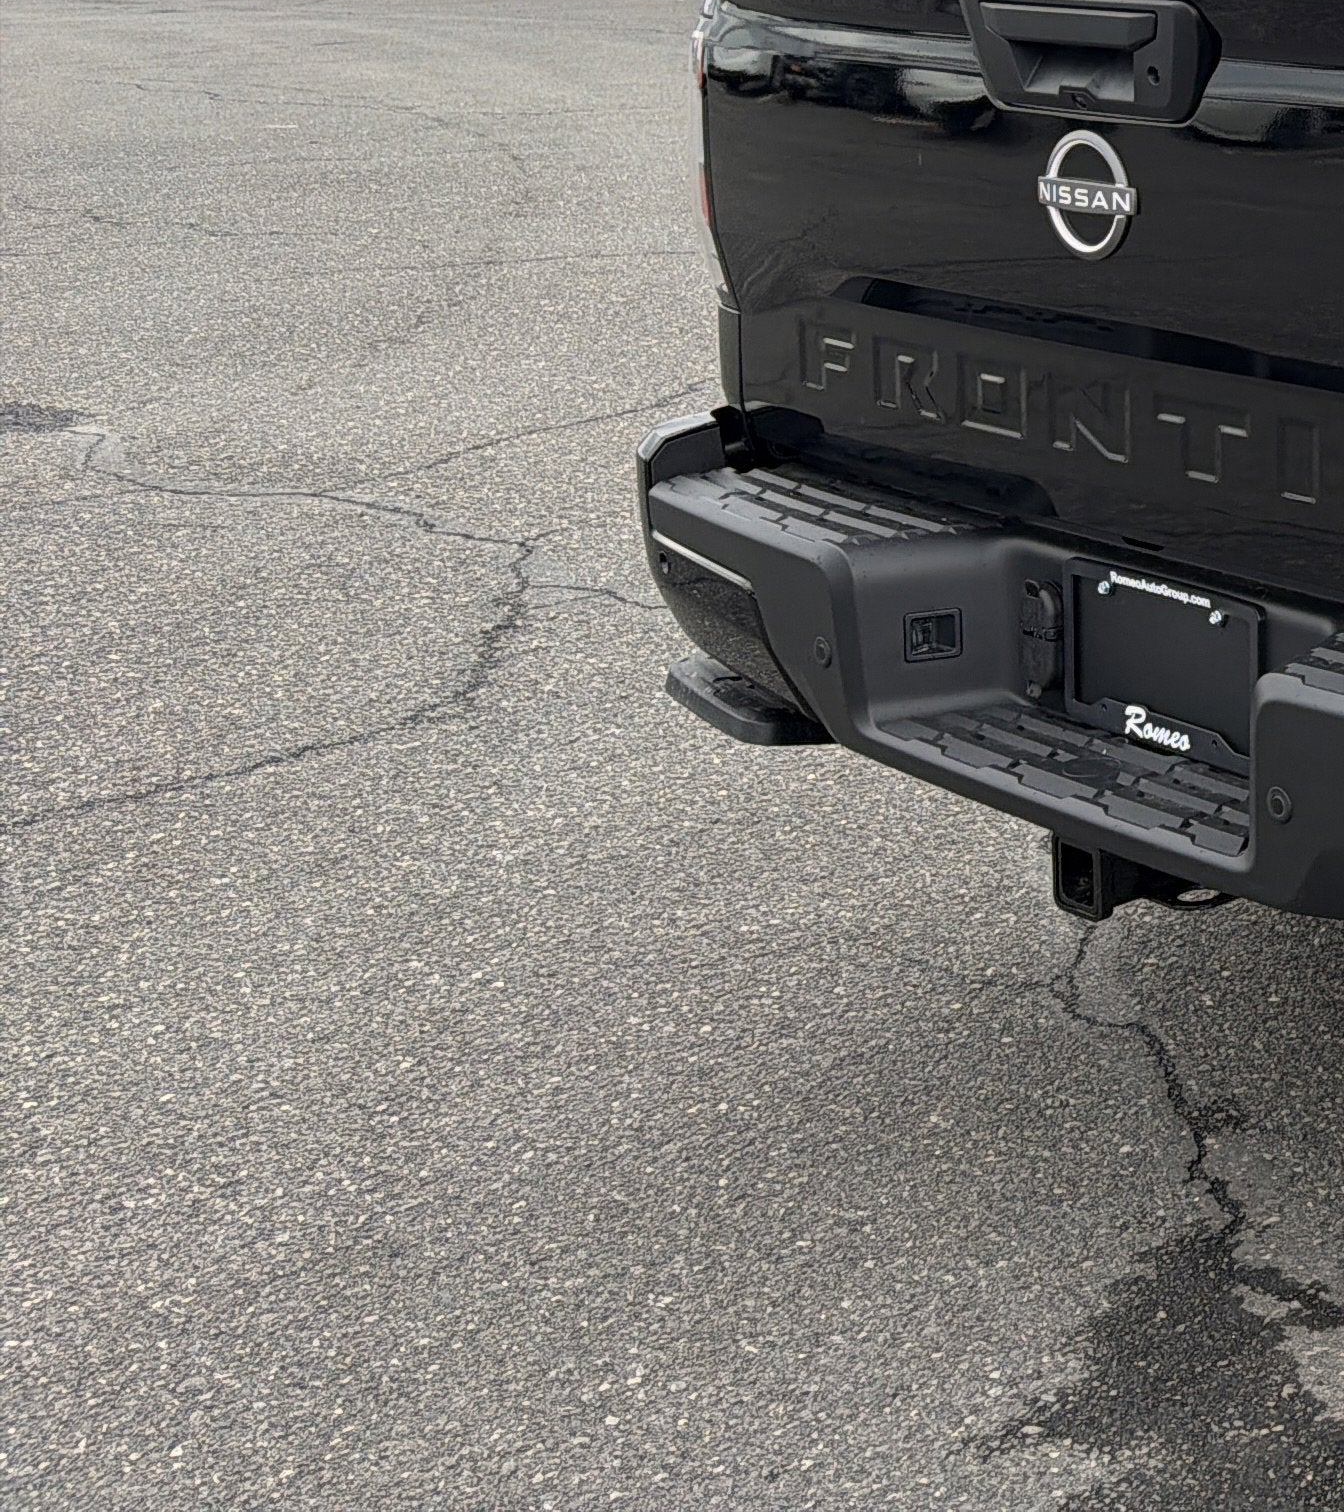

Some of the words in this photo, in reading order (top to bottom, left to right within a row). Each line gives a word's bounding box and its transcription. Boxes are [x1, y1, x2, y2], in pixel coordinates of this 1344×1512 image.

[1039, 181, 1131, 212] NISSAN
[1109, 570, 1212, 609] RomeoAutoGroup.com
[1124, 705, 1191, 752] Romeo
